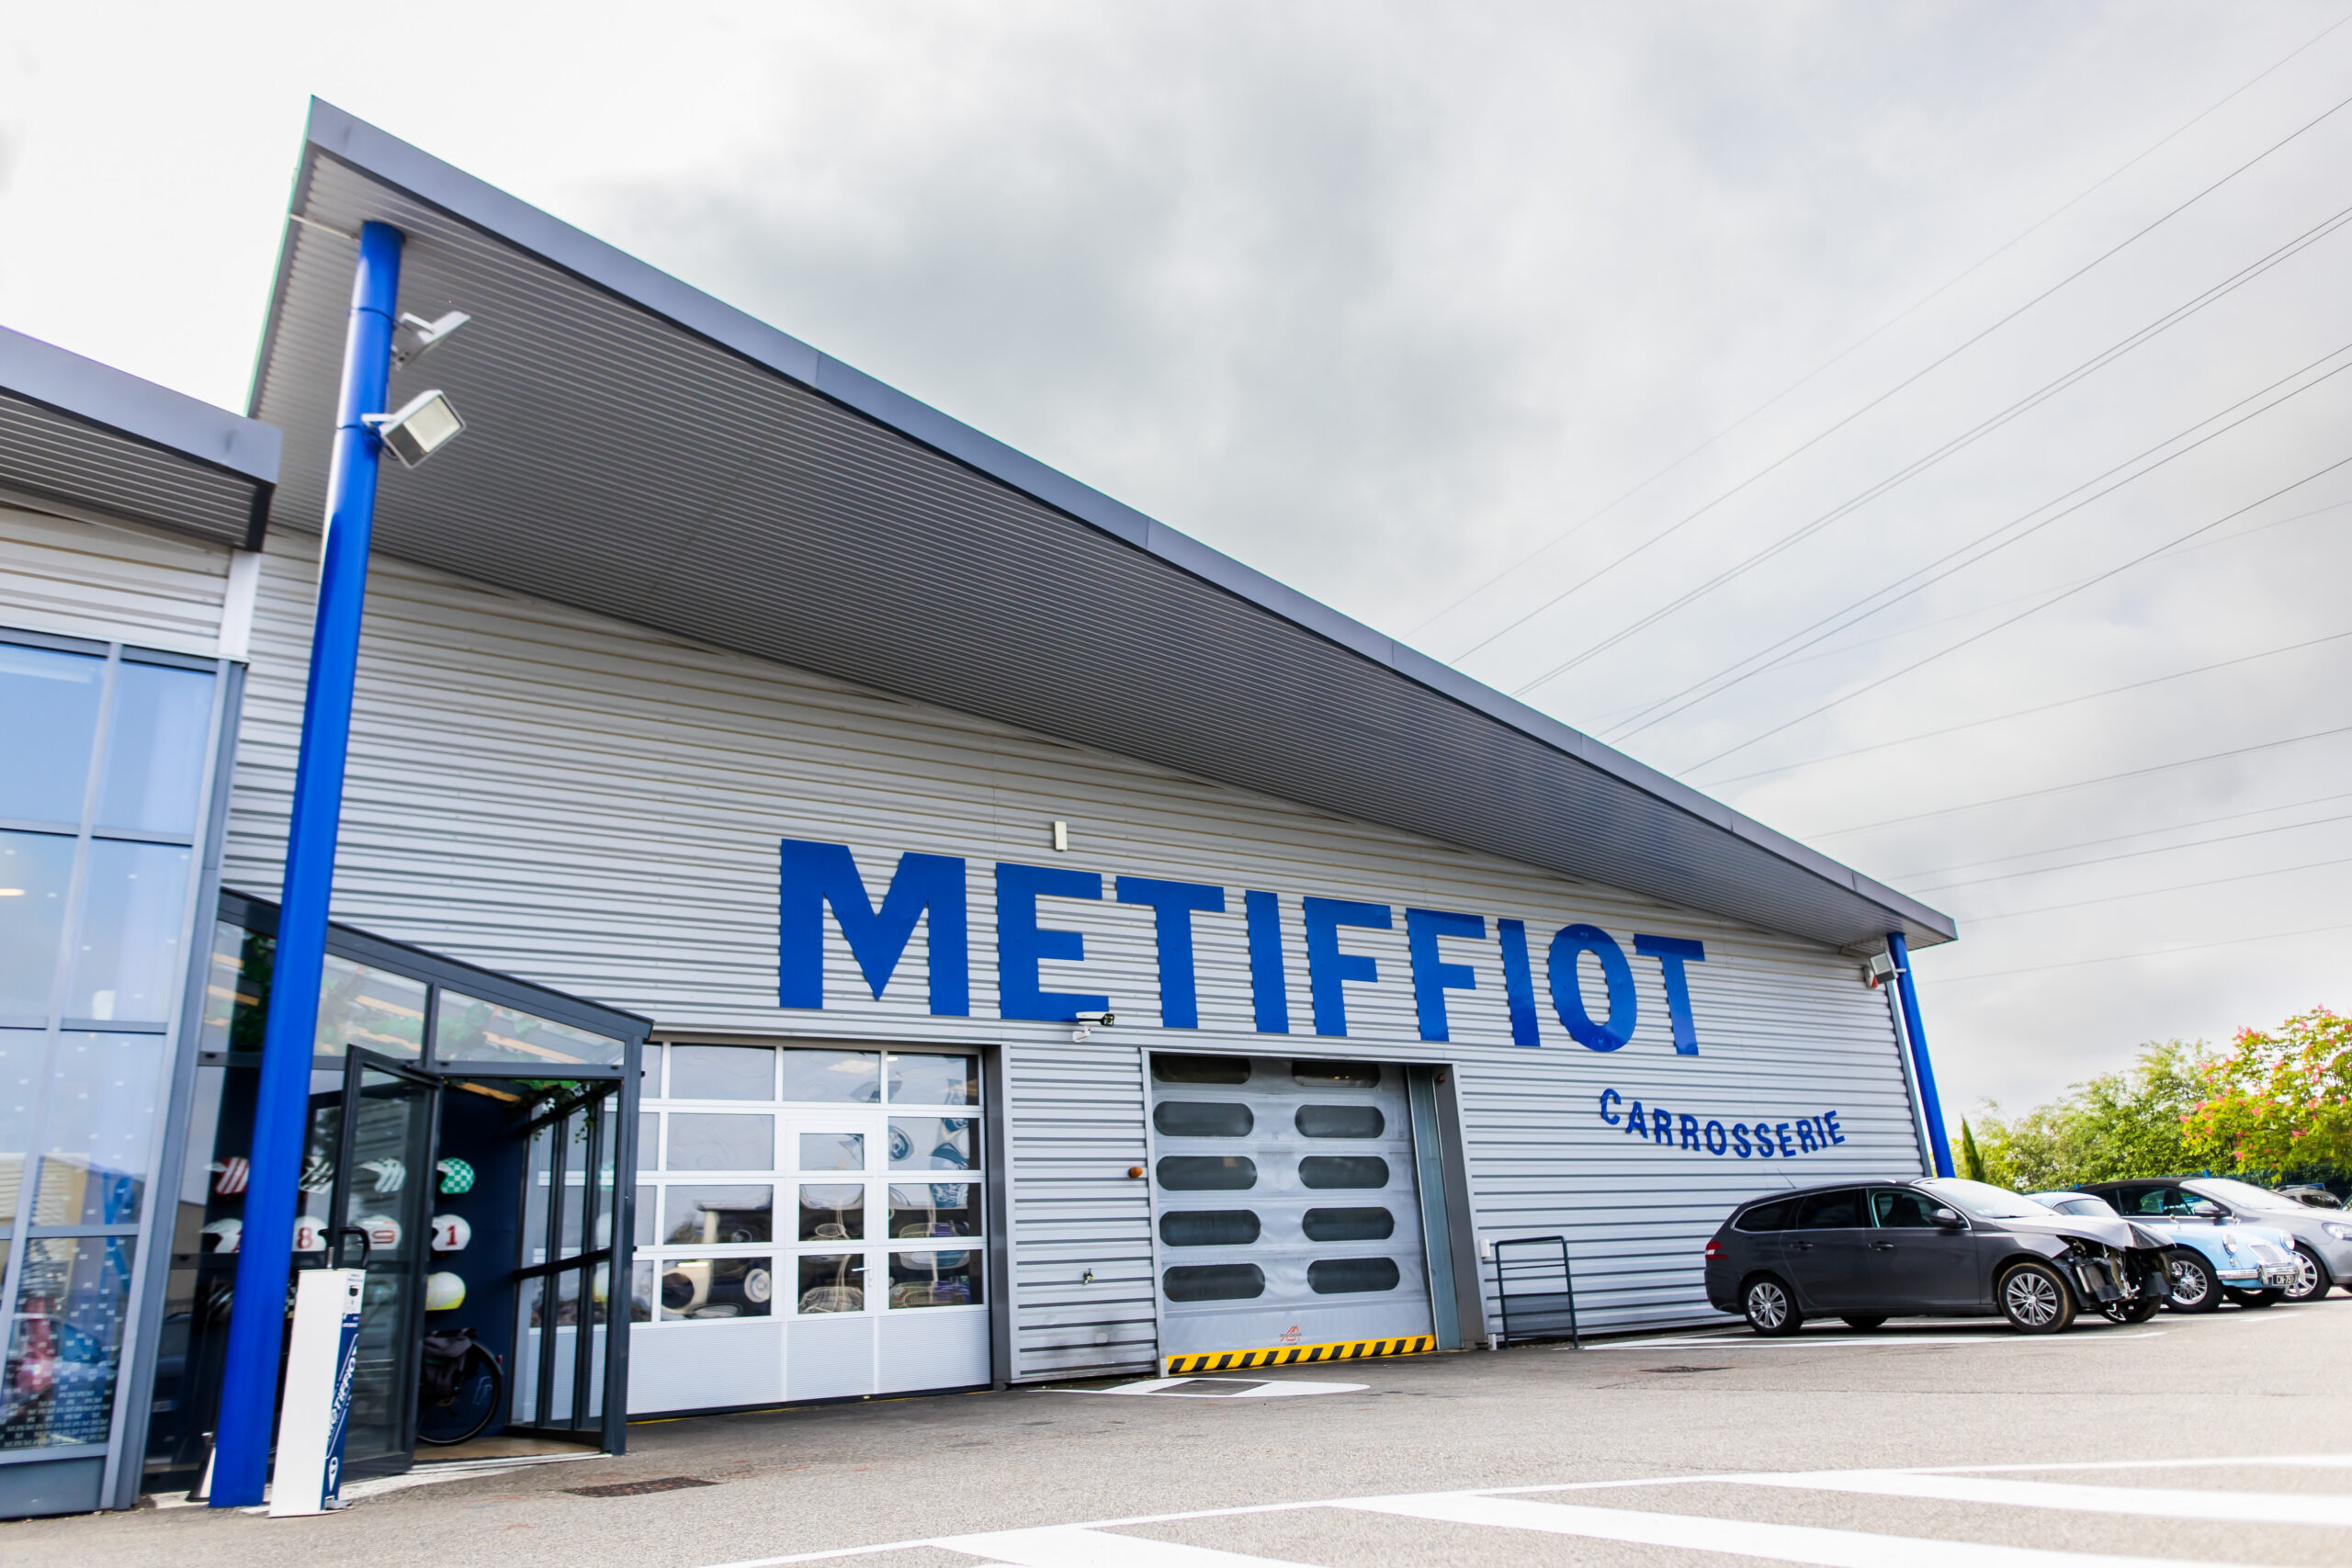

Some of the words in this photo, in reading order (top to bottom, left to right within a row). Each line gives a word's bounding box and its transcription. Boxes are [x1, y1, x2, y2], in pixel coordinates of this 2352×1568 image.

[779, 839, 1705, 1055] METIFFIOT
[1600, 1088, 1846, 1158] CARROSSERIE
[297, 1226, 313, 1249] 8
[446, 1224, 458, 1247] 1
